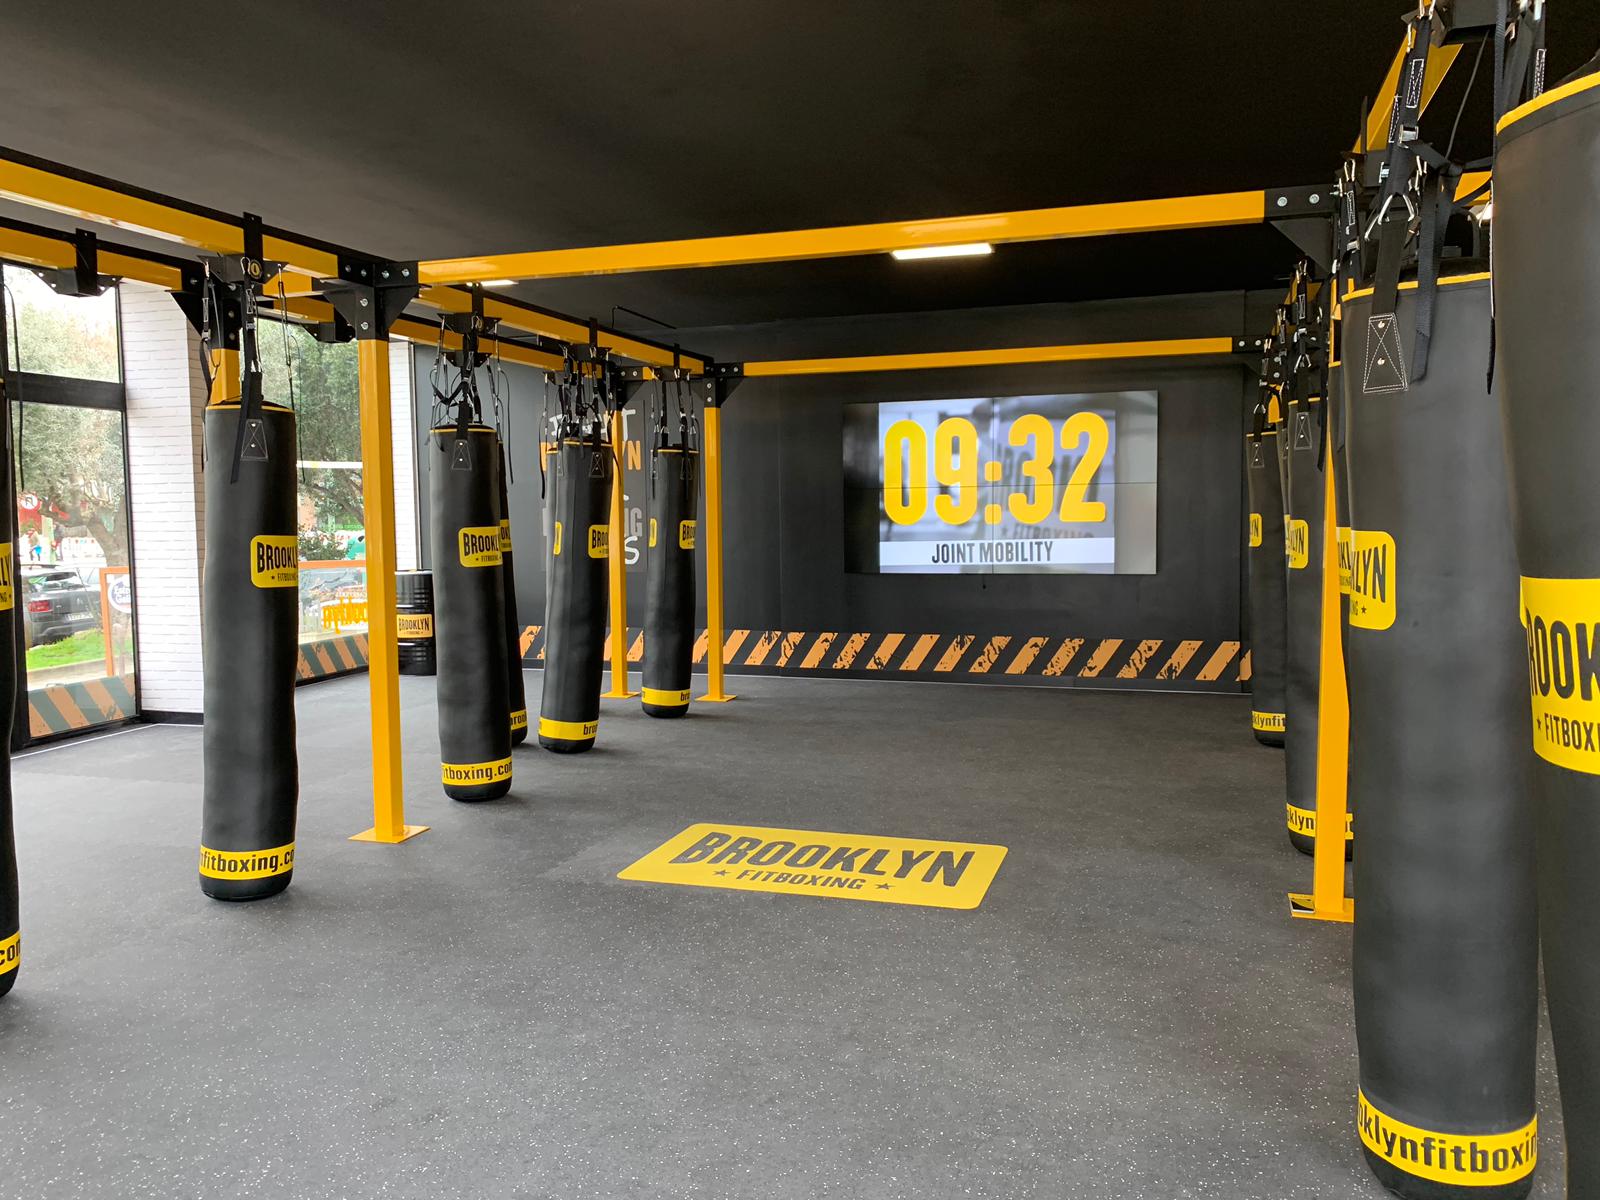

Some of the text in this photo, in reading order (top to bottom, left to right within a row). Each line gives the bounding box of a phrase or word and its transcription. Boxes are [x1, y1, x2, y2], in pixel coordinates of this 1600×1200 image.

[883, 411, 1109, 525] 09:32
[931, 540, 1053, 564] JOINT MOBILITY
[398, 617, 430, 631] BROOKLYN
[668, 831, 975, 888] BROOKLYN
[736, 869, 868, 890] FITBOXING
